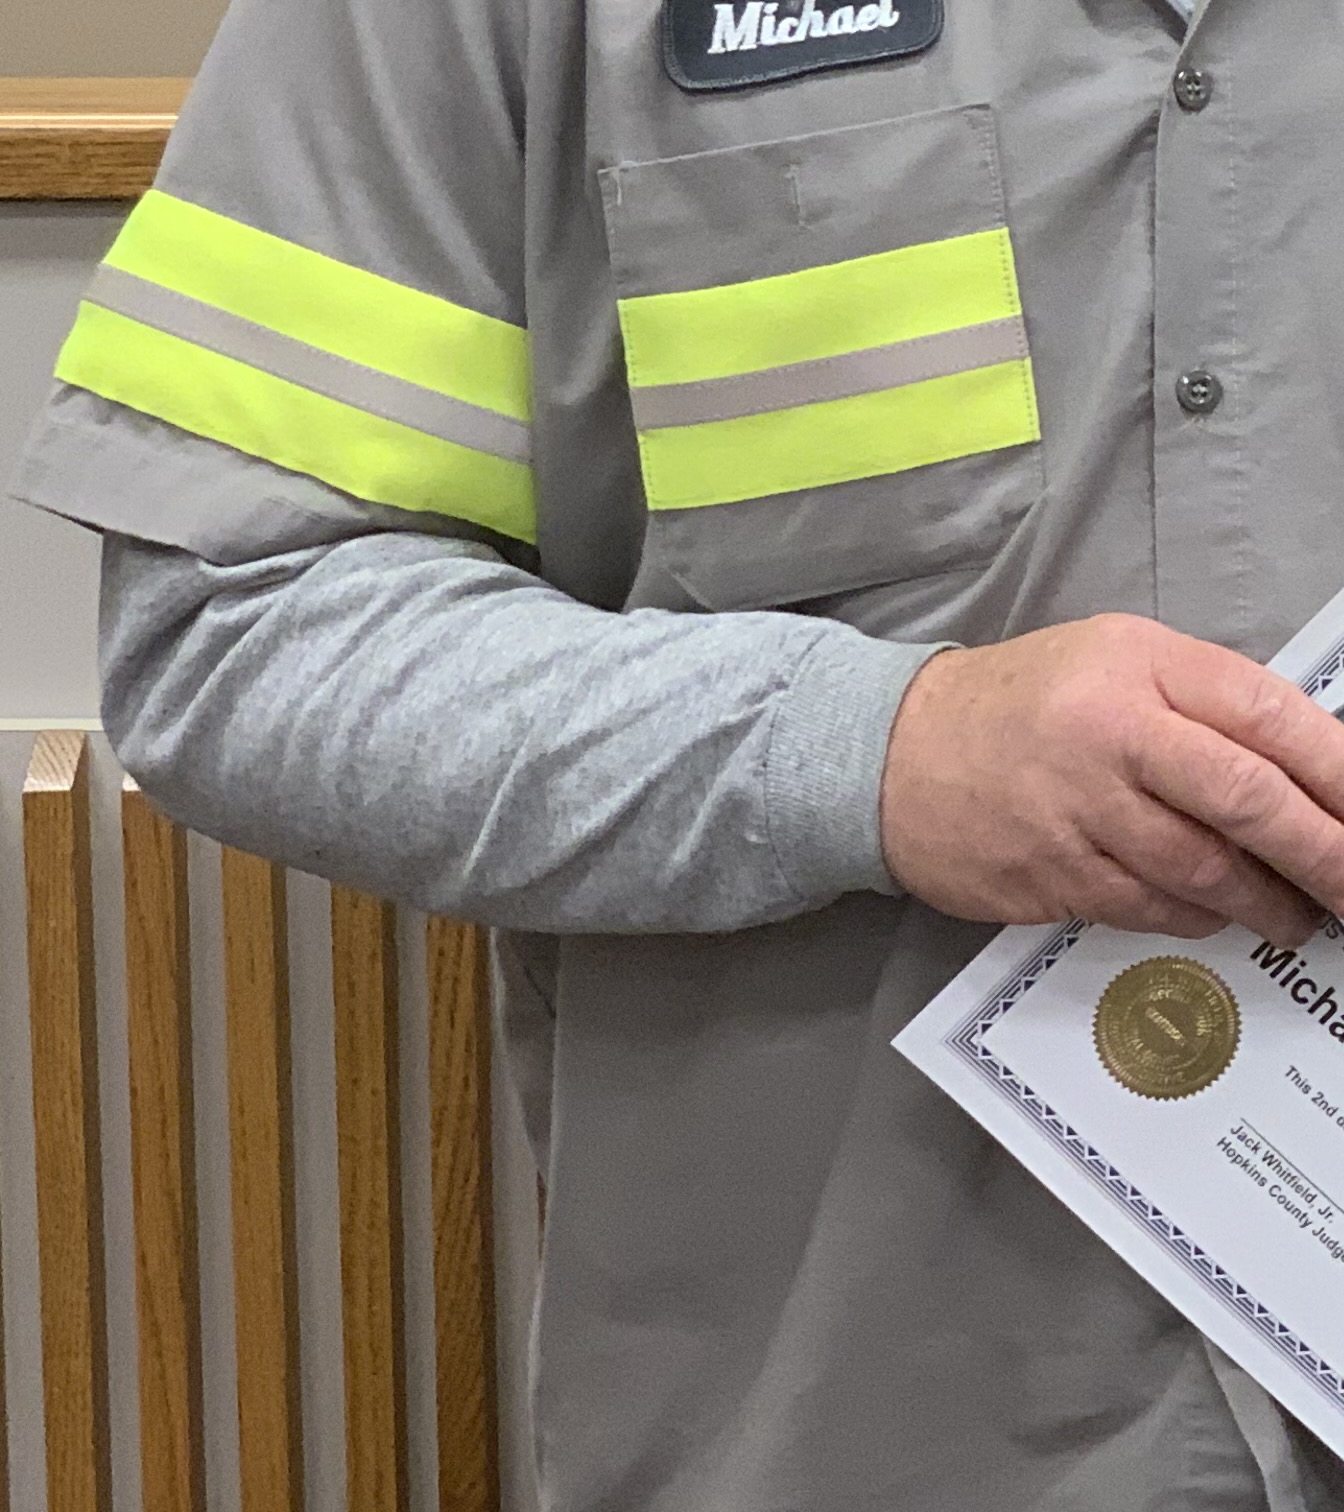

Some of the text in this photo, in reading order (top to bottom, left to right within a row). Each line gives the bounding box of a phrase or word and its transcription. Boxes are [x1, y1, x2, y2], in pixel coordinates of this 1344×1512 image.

[1285, 1065, 1311, 1094] This
[1311, 1091, 1338, 1117] 2nd
[1216, 1137, 1267, 1186] Hopkins
[1268, 1184, 1312, 1228] County
[1230, 1126, 1336, 1223] Jack Whitfield, Jr.
